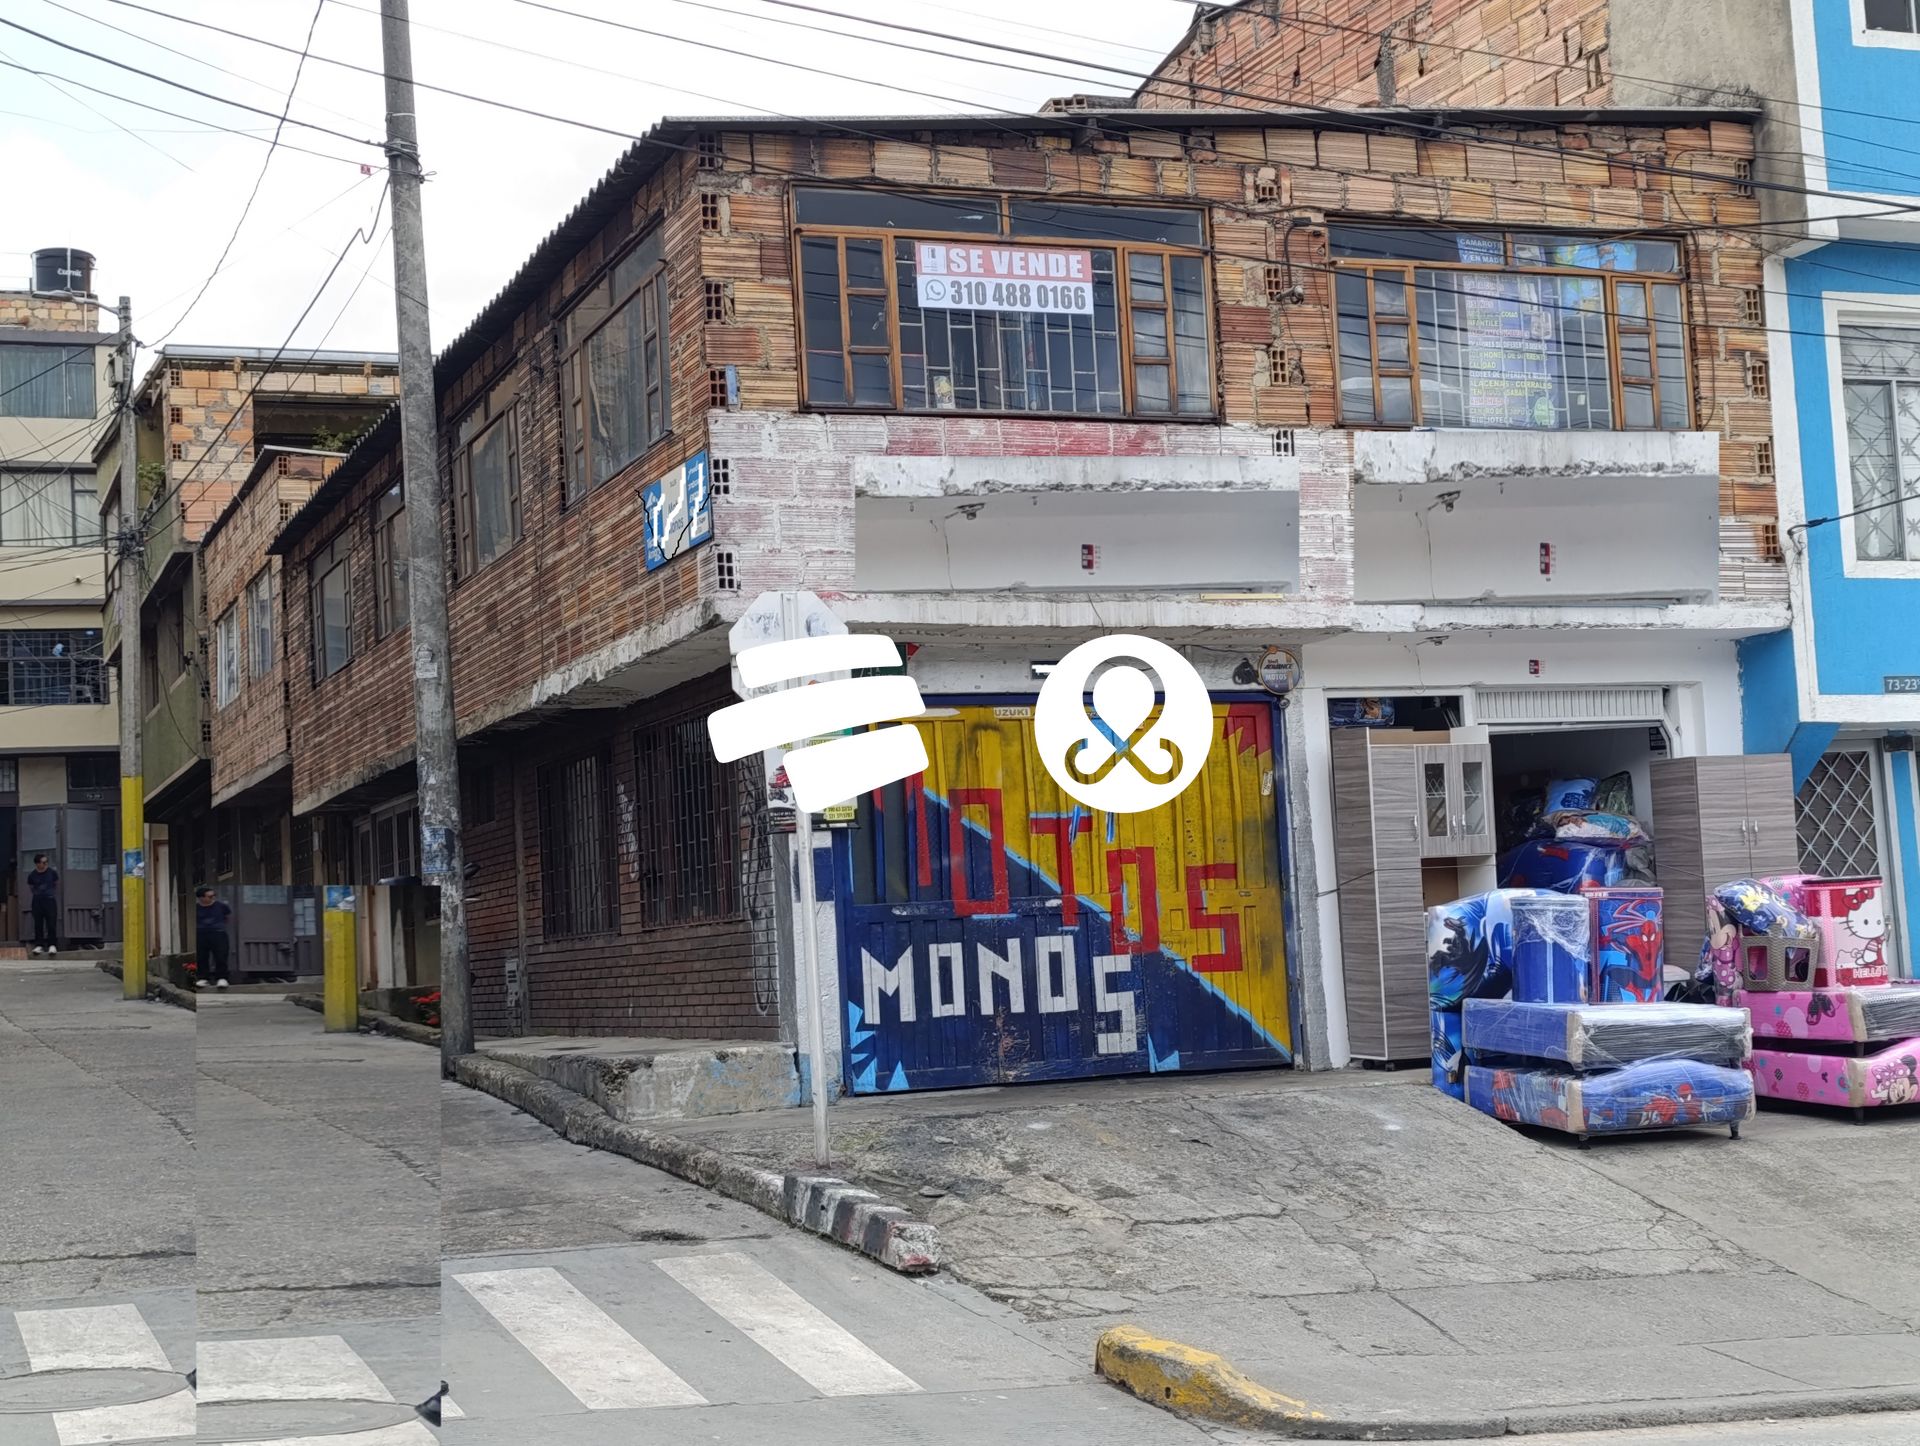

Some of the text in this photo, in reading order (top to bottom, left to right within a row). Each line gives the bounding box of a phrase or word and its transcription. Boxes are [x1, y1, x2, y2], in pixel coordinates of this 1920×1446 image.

[949, 248, 984, 274] SE
[991, 251, 1083, 279] VENDE
[950, 280, 1086, 310] 310 488 0166
[1852, 967, 1882, 979] HELLO
[860, 935, 1138, 1054] MONOS
